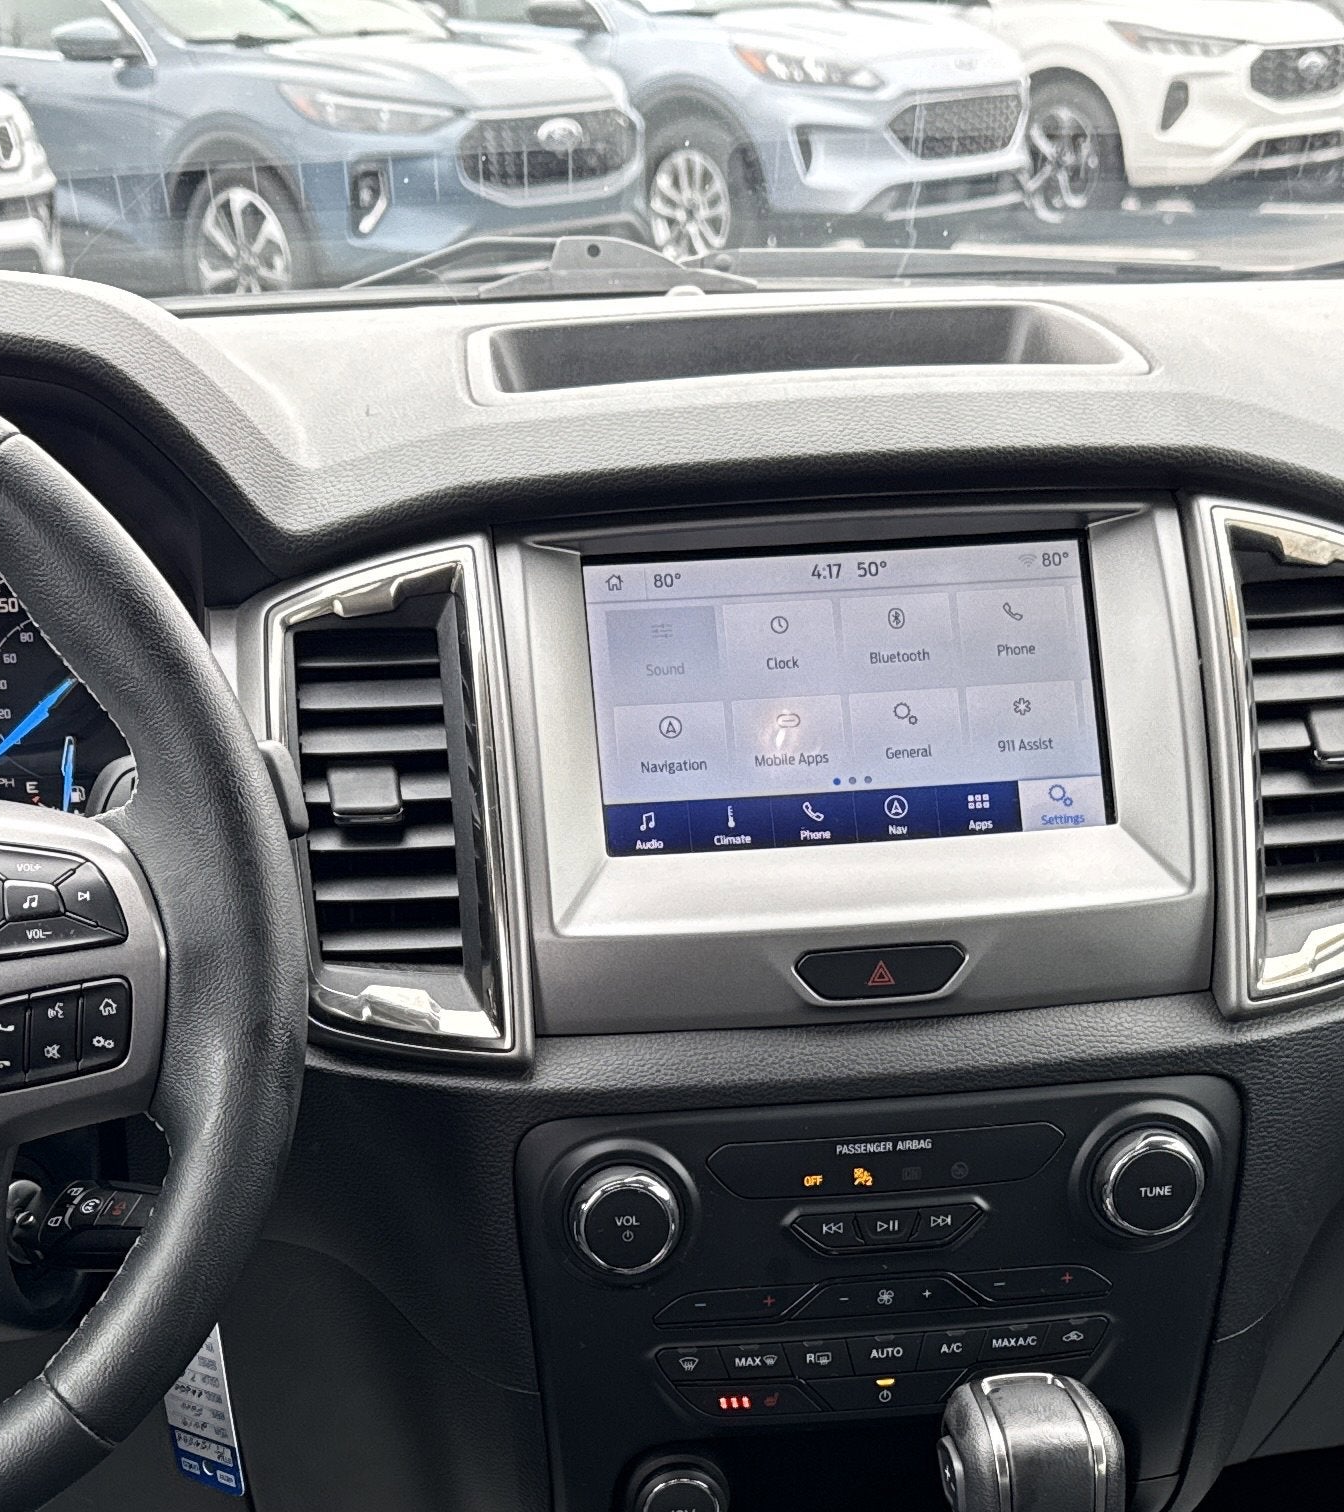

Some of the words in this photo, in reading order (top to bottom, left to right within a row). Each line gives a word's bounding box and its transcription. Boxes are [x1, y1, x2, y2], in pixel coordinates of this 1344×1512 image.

[1041, 552, 1069, 567] 80°
[811, 563, 842, 579] 4:17
[857, 561, 887, 577] 50°
[653, 573, 681, 588] 80°
[19, 632, 34, 643] 80
[997, 644, 1036, 656] Phone
[870, 649, 930, 664] Bluetooth
[766, 656, 799, 670] Clock
[646, 663, 685, 676] Sound
[998, 740, 1016, 753] 911
[1019, 738, 1054, 751] Assist
[886, 745, 932, 760] General
[755, 753, 795, 767] Mobile
[798, 753, 829, 766] Apps
[641, 760, 707, 774] Navigation
[26, 781, 39, 794] E
[1041, 813, 1085, 825] Settings
[889, 824, 907, 835] Nav
[969, 820, 993, 831] Apps
[714, 834, 751, 846] Climate
[800, 828, 831, 840] Phone
[636, 839, 664, 850] Audio
[836, 1142, 893, 1155] PASSENGER
[896, 1139, 932, 1151] AIRBAG
[803, 1175, 823, 1187] OFF
[1140, 1185, 1172, 1198] TUNE
[615, 1216, 640, 1226] VOL
[940, 1342, 963, 1354] A/C
[992, 1337, 1016, 1348] MAX
[1015, 1336, 1037, 1347] A/C
[870, 1347, 903, 1359] AUTO
[735, 1357, 762, 1367] MAX
